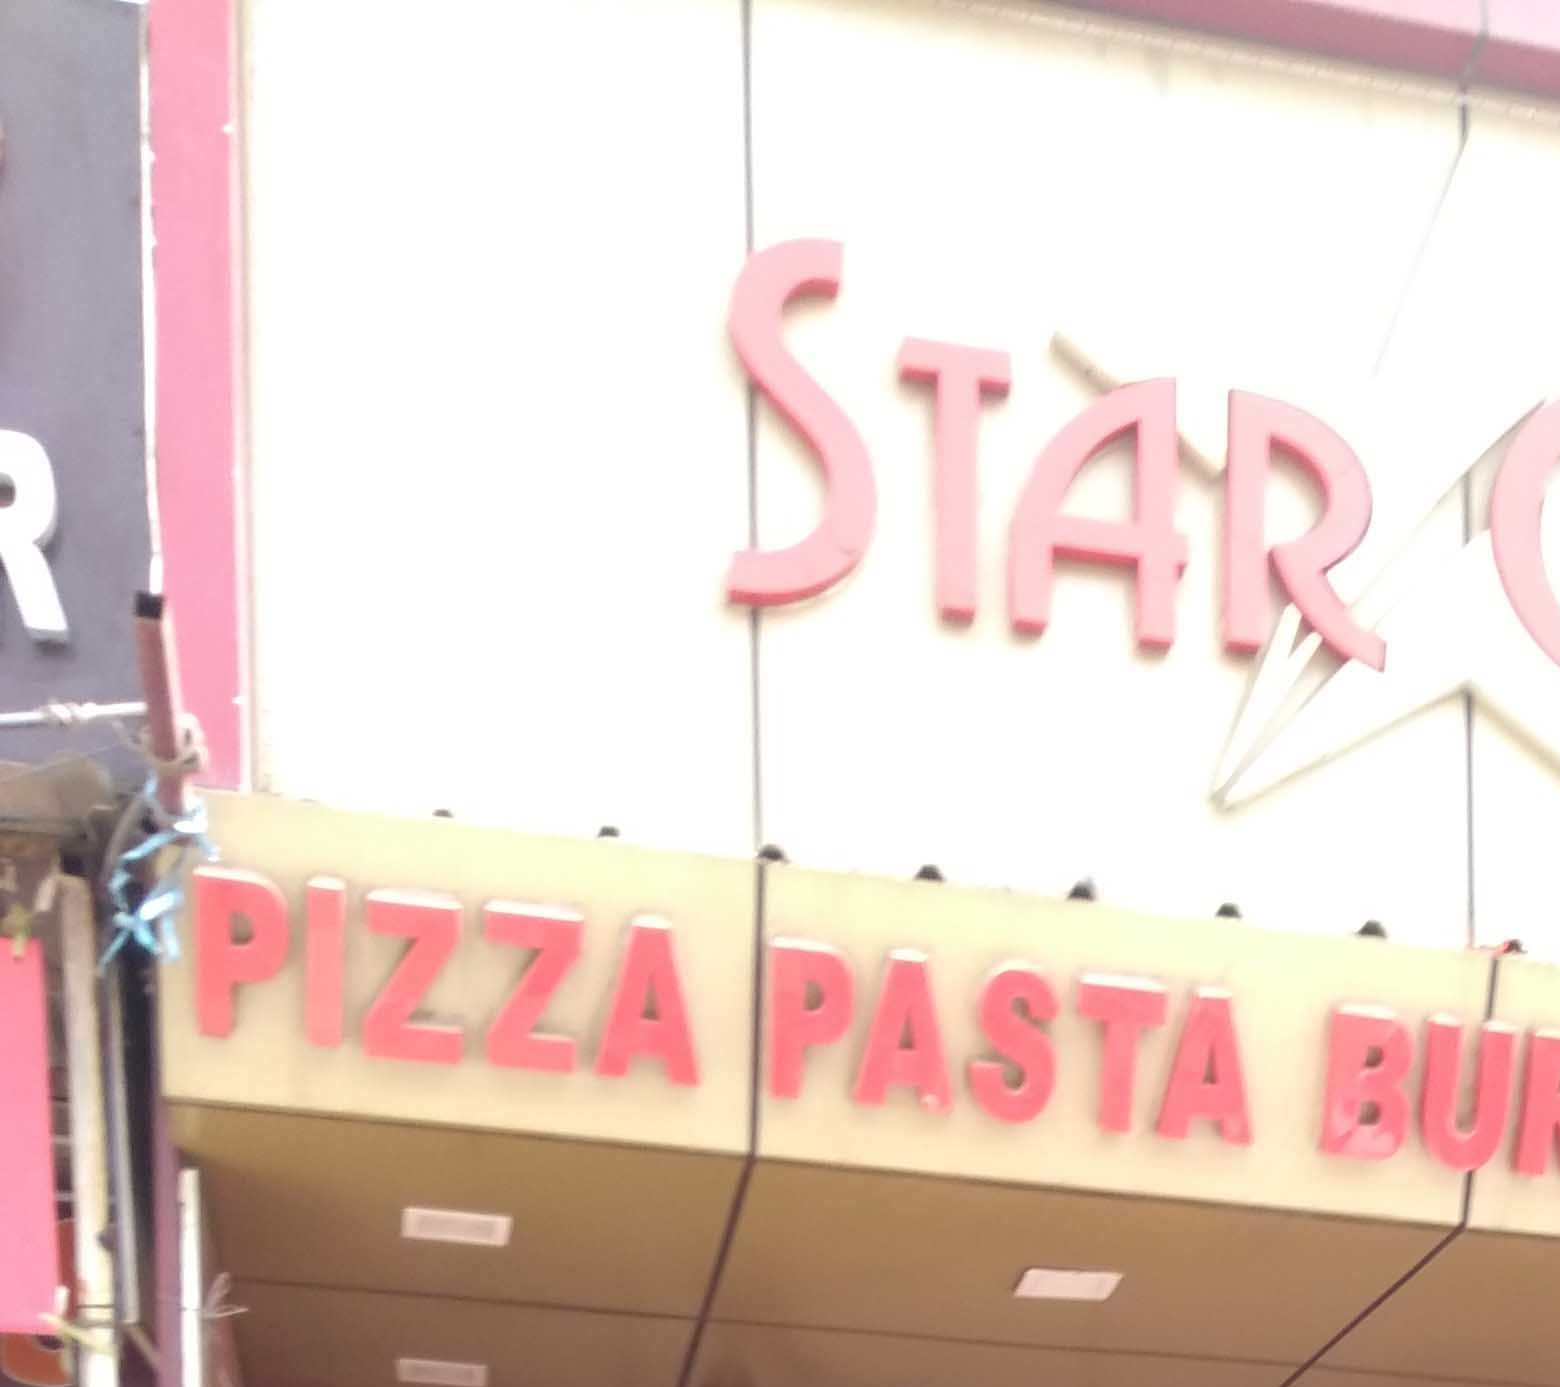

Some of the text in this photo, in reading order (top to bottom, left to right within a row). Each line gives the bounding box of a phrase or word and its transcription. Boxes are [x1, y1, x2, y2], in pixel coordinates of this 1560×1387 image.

[726, 238, 1386, 674] STAR
[193, 864, 700, 1088] PIZZA
[768, 935, 1252, 1148] PASTA
